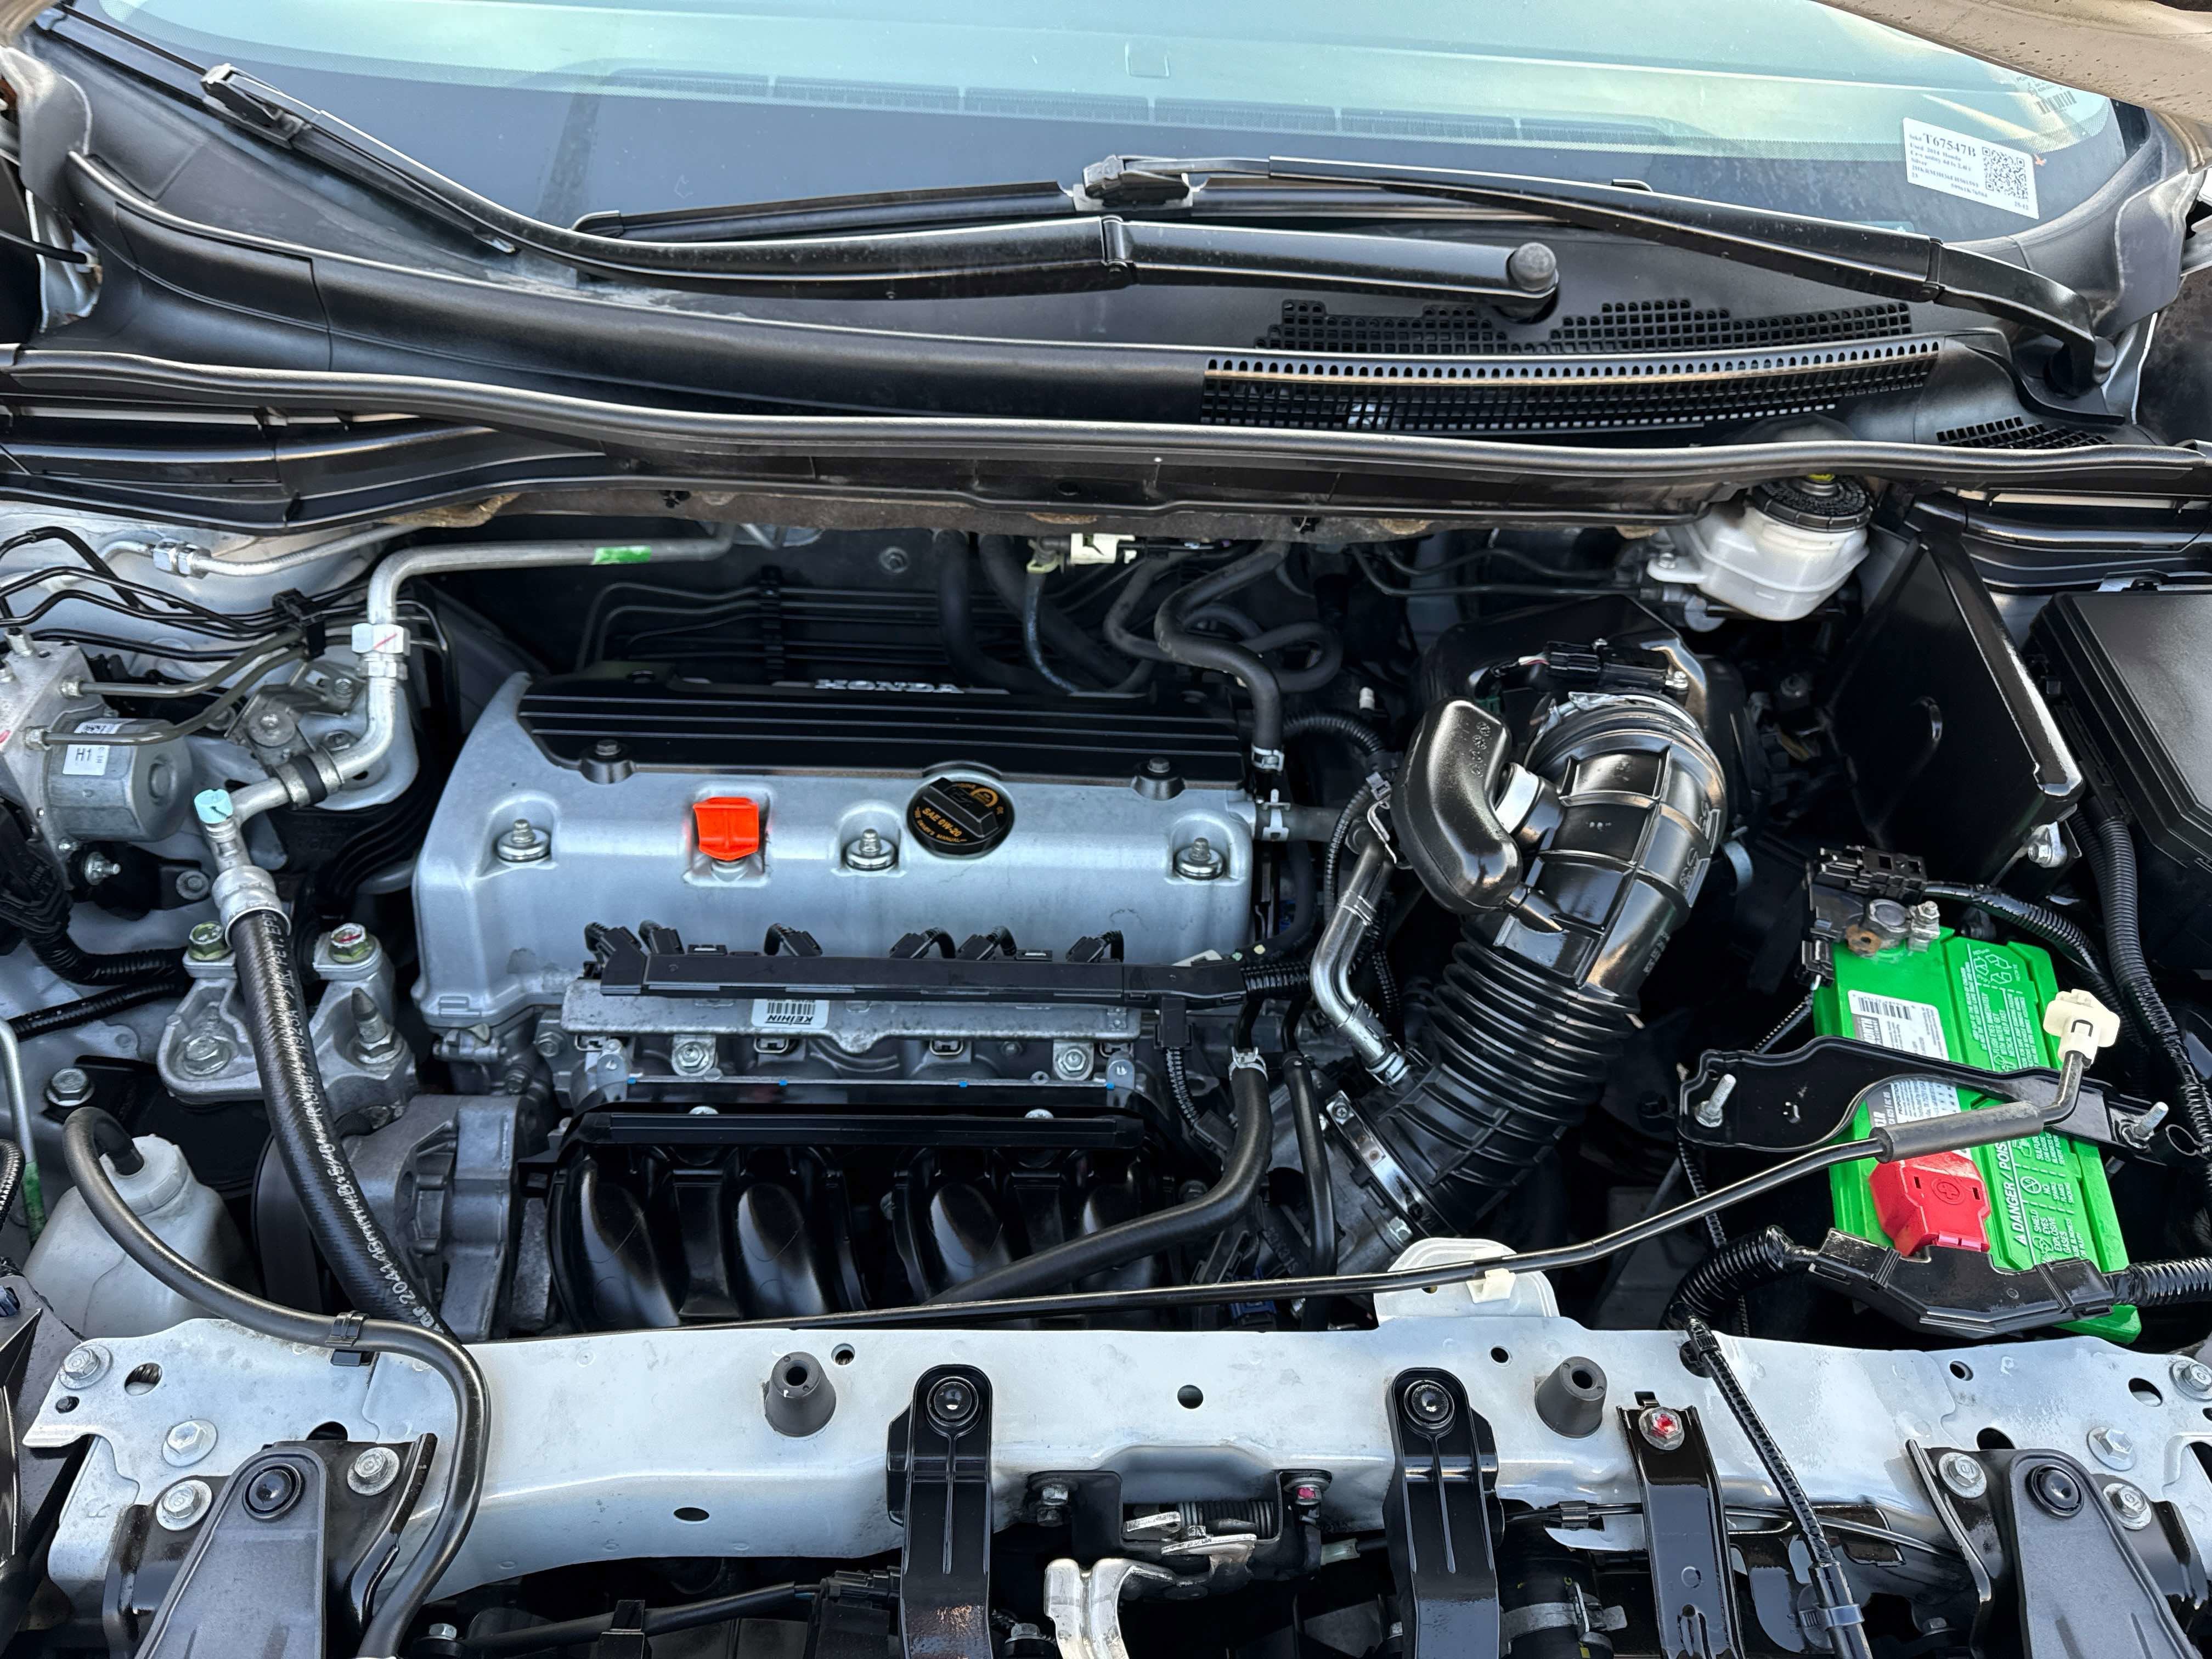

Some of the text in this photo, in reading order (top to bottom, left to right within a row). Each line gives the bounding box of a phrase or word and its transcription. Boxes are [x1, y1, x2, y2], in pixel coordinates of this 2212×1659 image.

[1923, 133, 1976, 157] T67547B
[815, 679, 964, 693] HONDA
[75, 747, 92, 761] H1
[922, 808, 941, 822] SAE
[266, 909, 282, 937] EPD
[1982, 992, 1995, 1023] IMMEDIATELY
[766, 1015, 814, 1025] KEIHIN
[2002, 1022, 2010, 1035] HELP
[1873, 1020, 1881, 1045] PLACEMENT
[1987, 1024, 1996, 1037] EYES
[1989, 1037, 2000, 1054] FLUSH
[2005, 1036, 2015, 1057] MEDICAL
[1996, 1142, 2011, 1170] POIS
[2042, 1184, 2051, 1194] NO
[2050, 1182, 2059, 1200] SPARKS
[2058, 1184, 2067, 1202] FLAMES
[2065, 1182, 2074, 1204] SMOKING
[2004, 1182, 2024, 1232] DANGER
[2030, 1209, 2042, 1232] SHIELD
[2041, 1218, 2051, 1234] EYES
[2047, 1217, 2062, 1251] EXPLOSIVE
[2059, 1231, 2071, 1253] GASES
